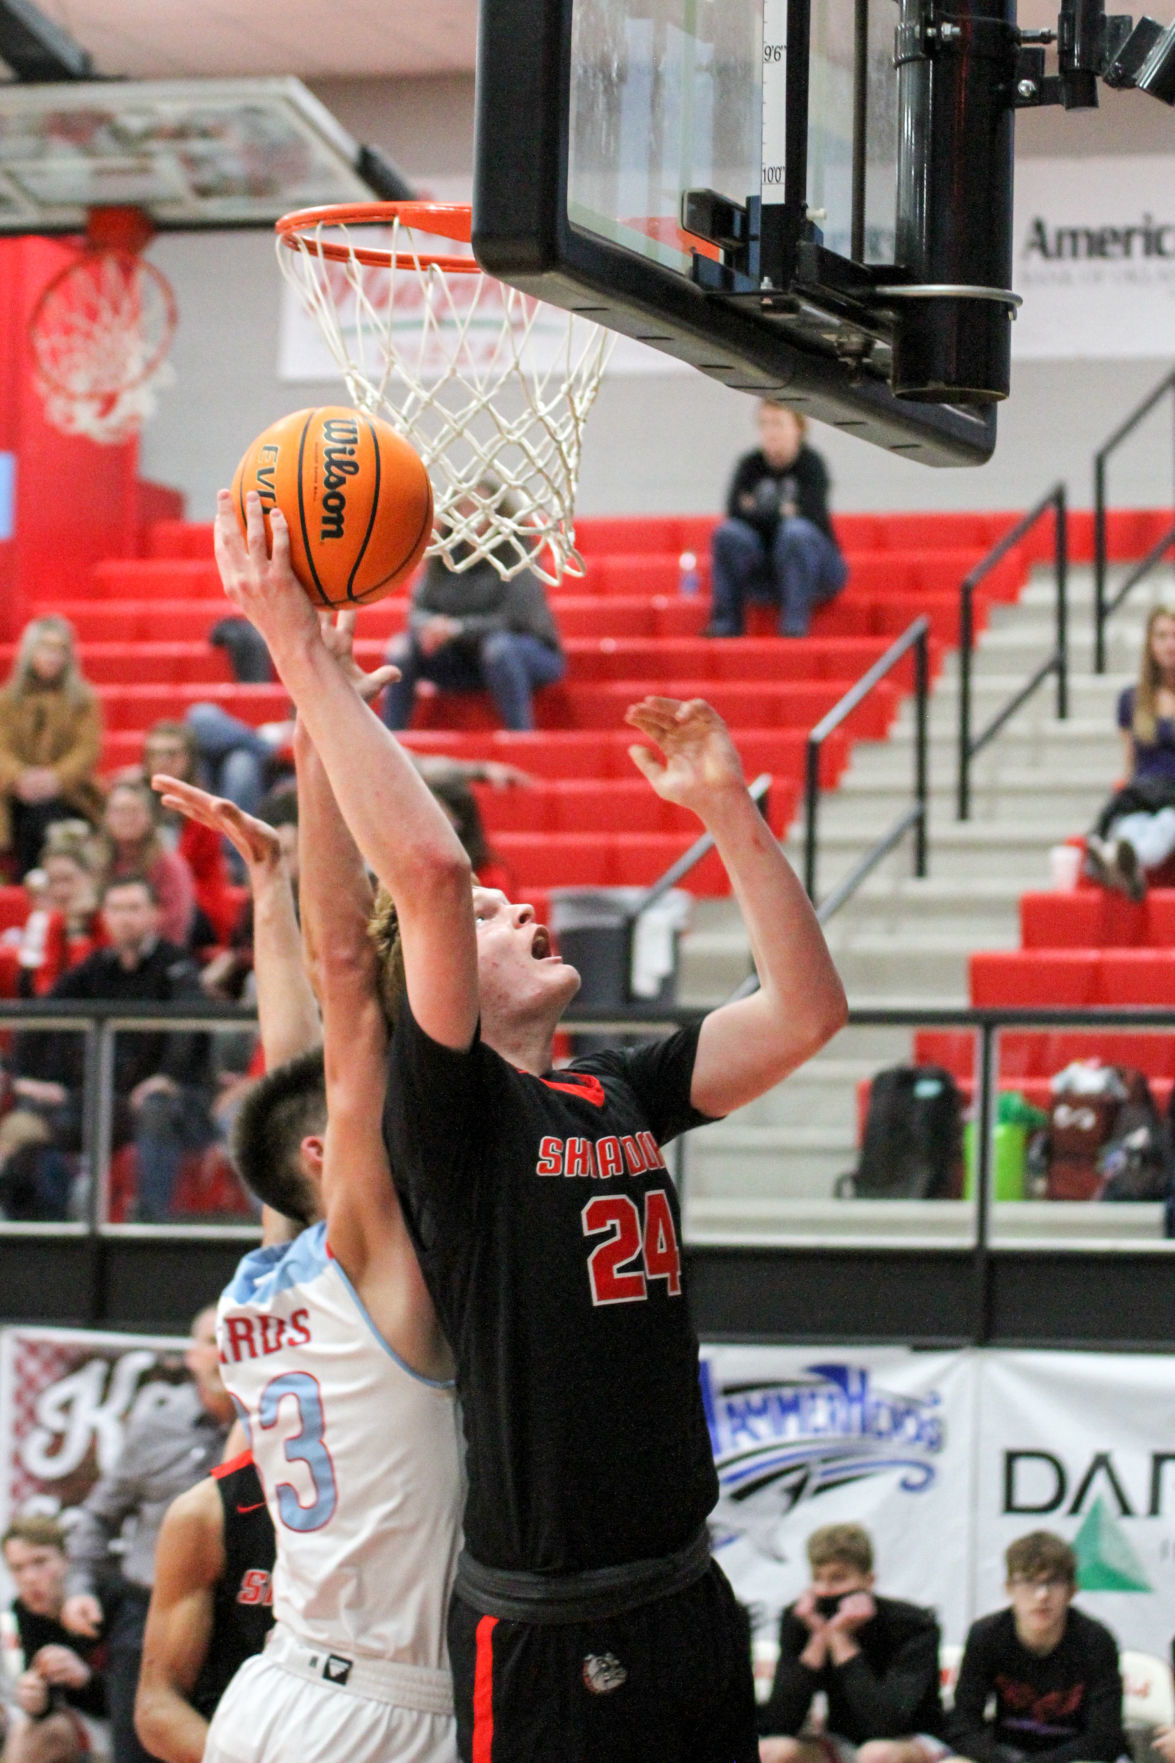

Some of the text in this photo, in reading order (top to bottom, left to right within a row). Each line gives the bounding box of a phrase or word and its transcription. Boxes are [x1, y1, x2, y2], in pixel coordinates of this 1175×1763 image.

[1022, 212, 1175, 259] Americ
[320, 418, 360, 541] Wilson
[581, 1189, 682, 1307] 24
[218, 1308, 312, 1365] RDS
[230, 1371, 339, 1533] 3
